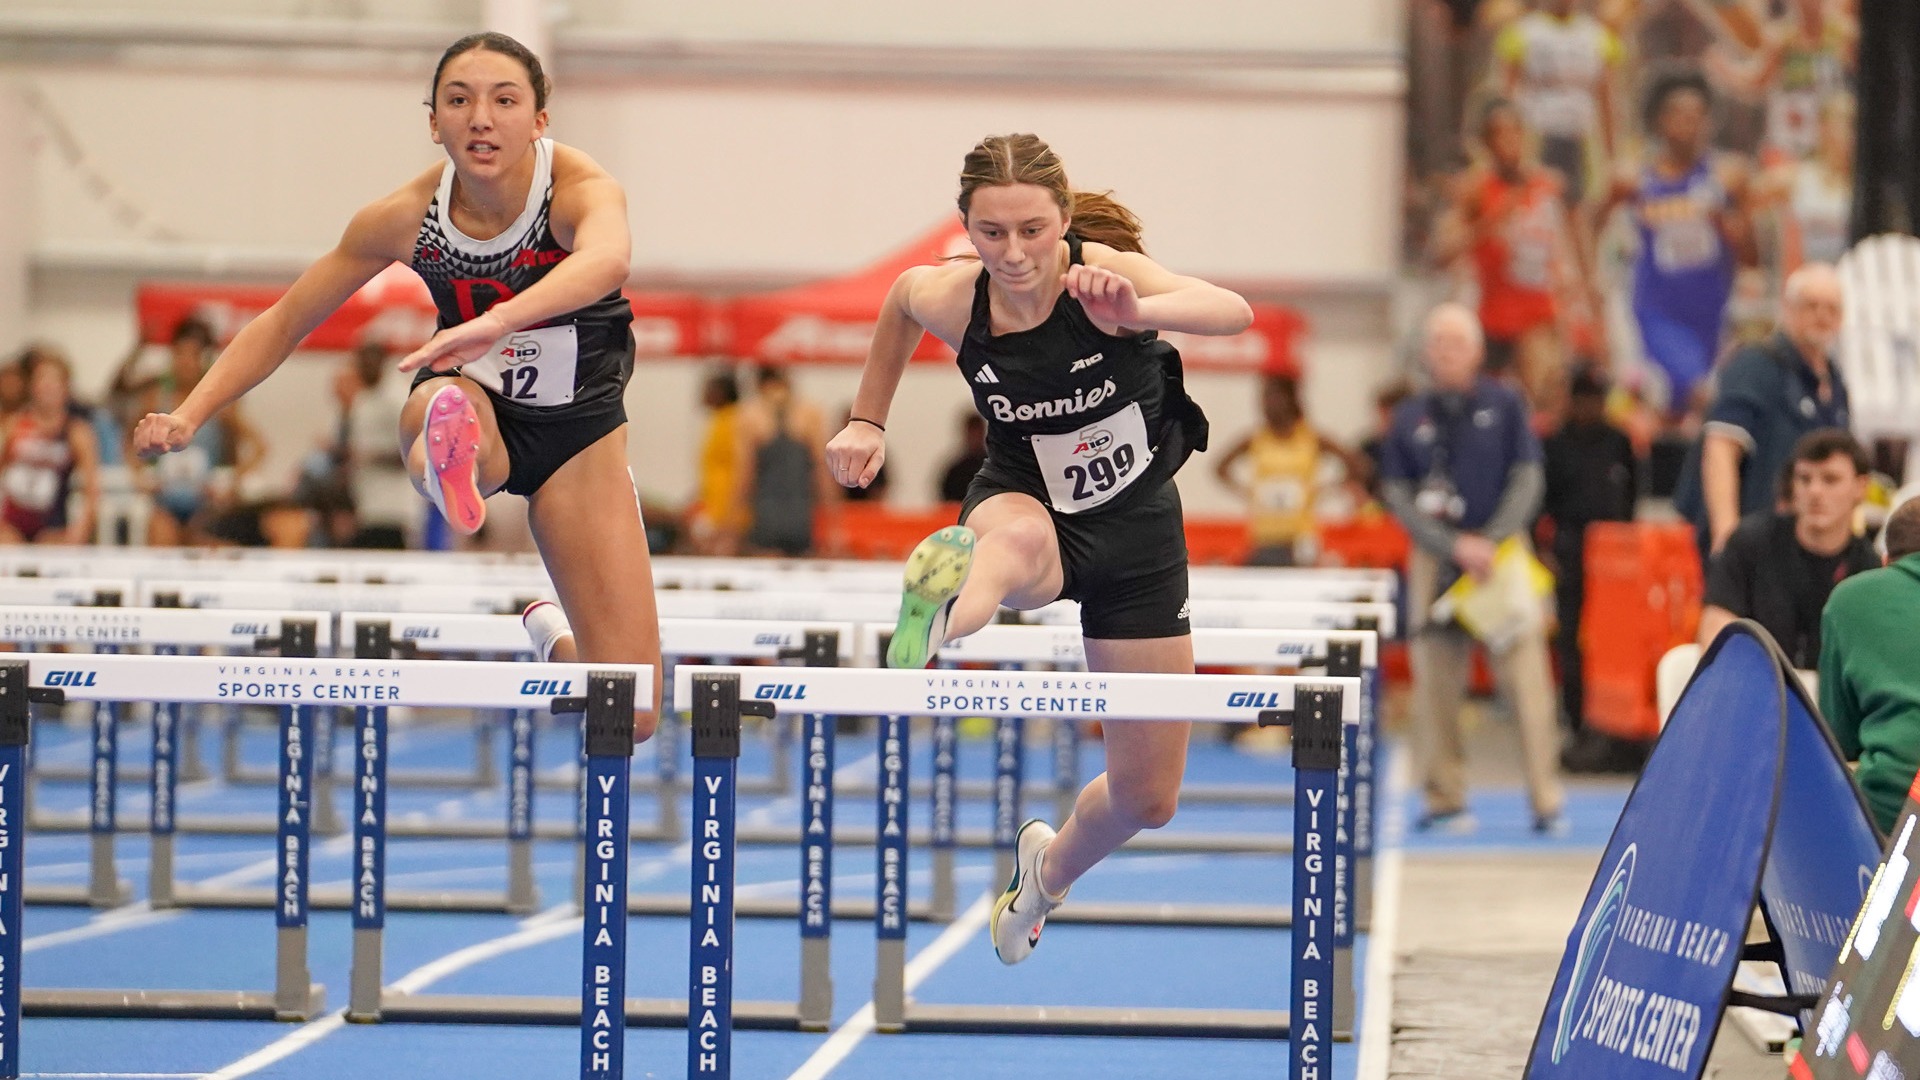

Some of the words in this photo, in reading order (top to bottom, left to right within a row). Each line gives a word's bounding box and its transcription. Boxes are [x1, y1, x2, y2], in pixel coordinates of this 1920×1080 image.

[1069, 352, 1104, 373] A10
[500, 366, 539, 399] 12
[987, 379, 1117, 422] Bonnies
[1072, 435, 1109, 455] A10
[1064, 443, 1135, 501] 299
[4, 625, 67, 637] SPORTS
[75, 627, 140, 638] CENTER
[231, 623, 270, 635] GILL
[402, 626, 440, 639] GILL
[1277, 643, 1315, 656] GILL
[44, 671, 97, 687] GILL
[219, 666, 318, 676] VIRGINIA
[336, 668, 400, 678] BEACH
[219, 682, 301, 698] SPORTS
[314, 684, 400, 700] CENTER
[520, 679, 572, 696] GILL
[927, 679, 1025, 688] VIRGINIA
[1043, 681, 1108, 690] BEACH
[754, 683, 806, 700] GILL
[927, 696, 1009, 711] SPORTS
[1020, 697, 1107, 712] CENTER
[1227, 692, 1280, 708] GILL
[361, 705, 378, 826] IRGINIA
[284, 835, 300, 917] BEACH
[360, 836, 376, 919] BEACH
[594, 775, 616, 946] VIRGINIA
[701, 776, 722, 947] VIRGINIA
[1302, 789, 1324, 960] VIRGINIA
[806, 845, 823, 927] BEACH
[883, 848, 899, 929] BEACH
[1618, 903, 1678, 954] VIRGINIA
[1677, 920, 1730, 967] BEACH
[592, 965, 611, 1072] BEACH
[699, 966, 718, 1072] BEACH
[1301, 979, 1320, 1080] BEACH
[1582, 975, 1645, 1054] SPORTS
[1632, 992, 1701, 1073] CENTER
